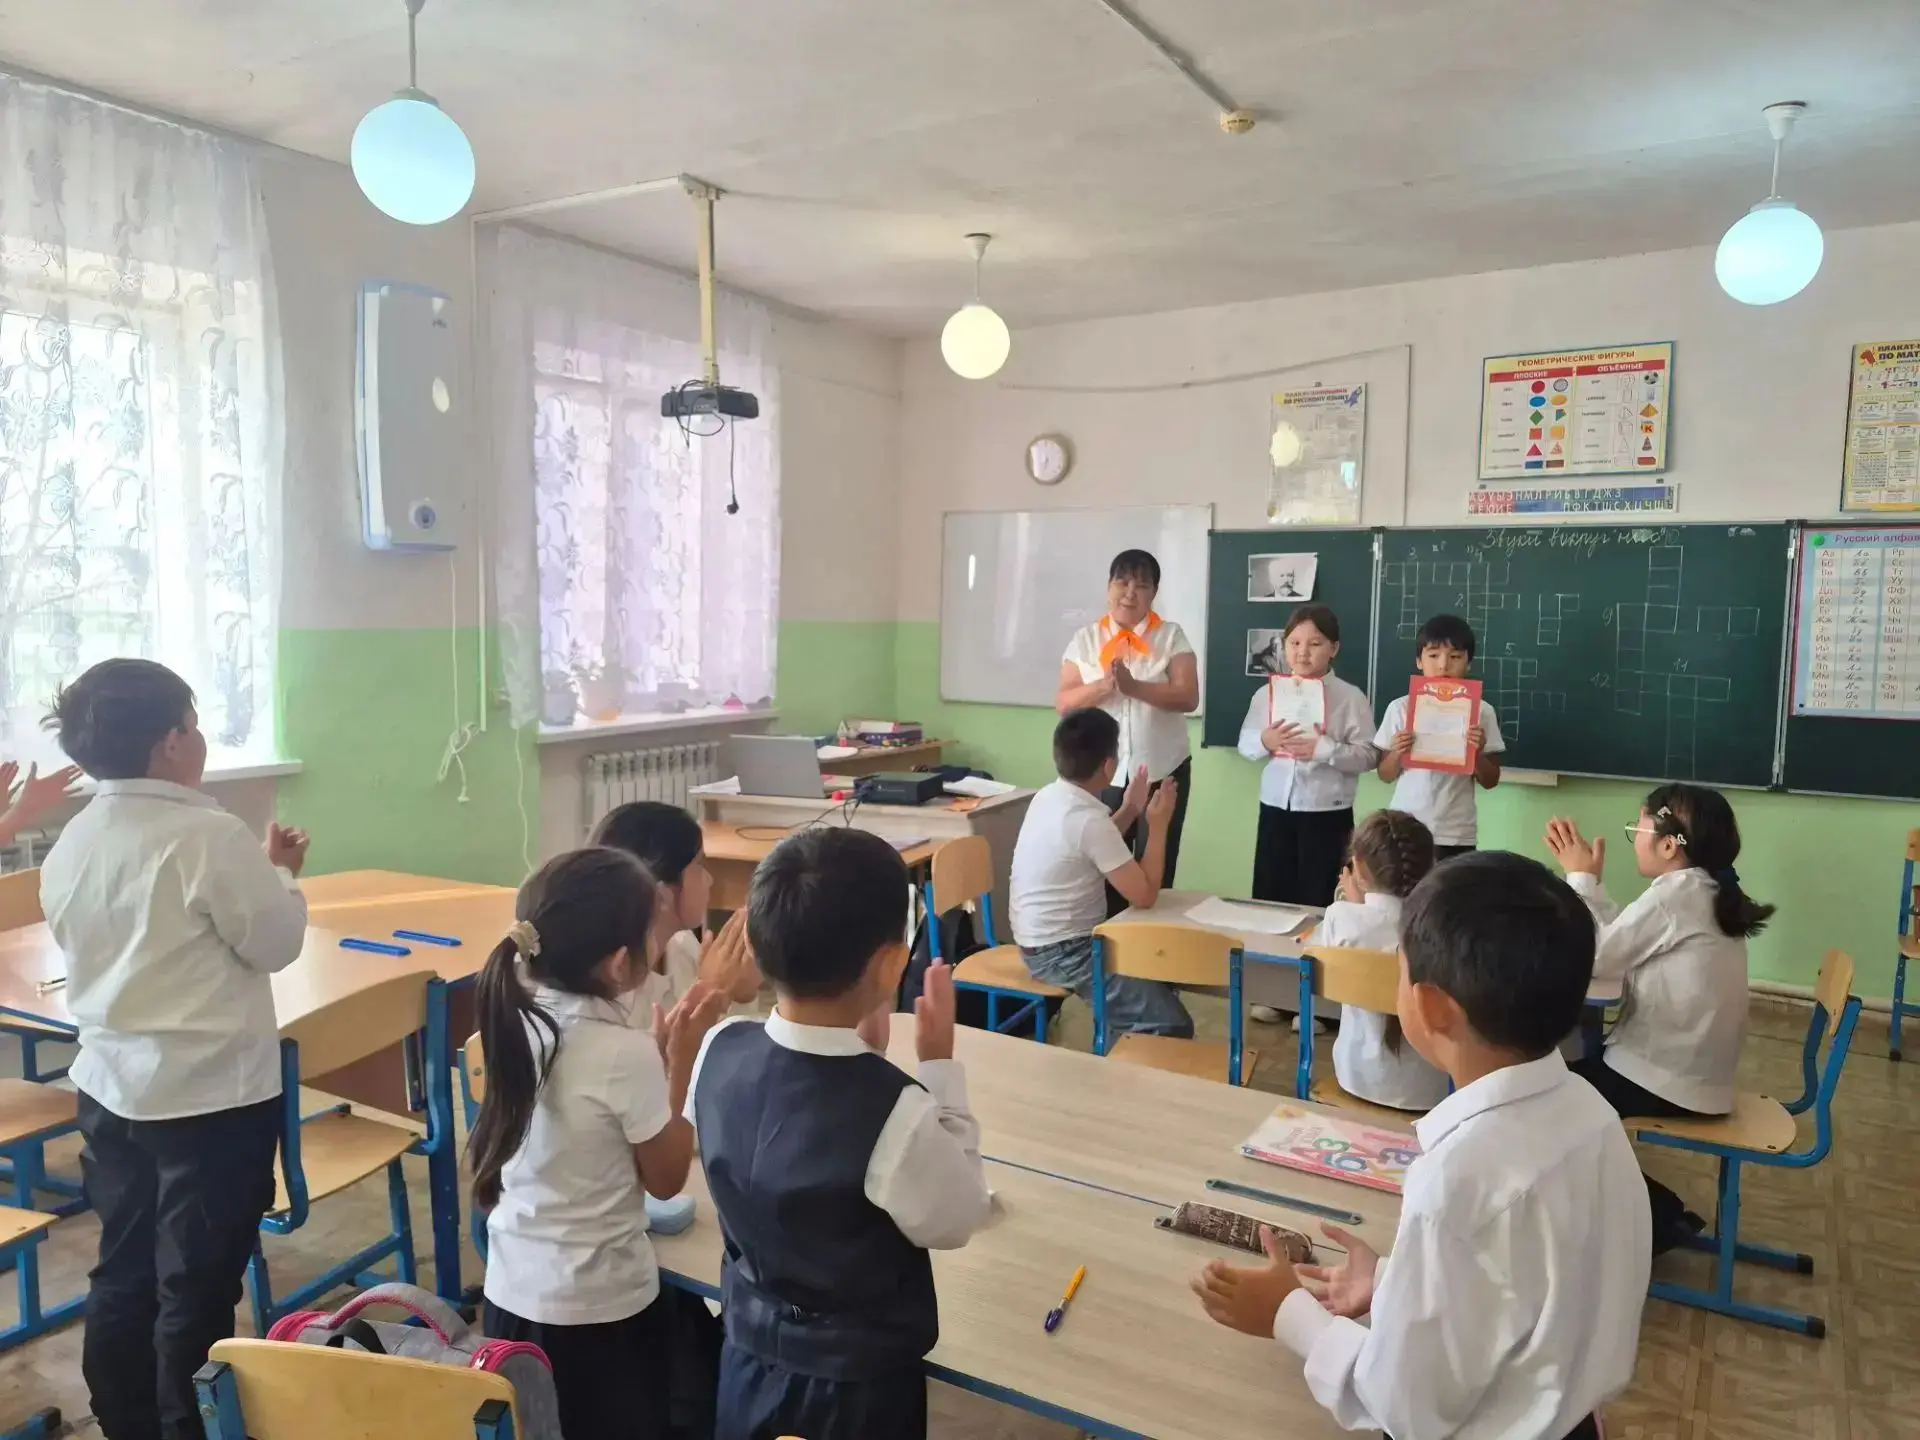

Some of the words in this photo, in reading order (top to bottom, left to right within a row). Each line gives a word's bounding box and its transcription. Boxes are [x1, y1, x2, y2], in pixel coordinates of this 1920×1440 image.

[1517, 355, 1595, 367] ГЕОМЕТРИЧЕСКИЕ
[1599, 351, 1635, 360] ФИГУРЫ
[1513, 371, 1548, 380] ПЛОСКИЕ
[1834, 532, 1880, 545] Русский
